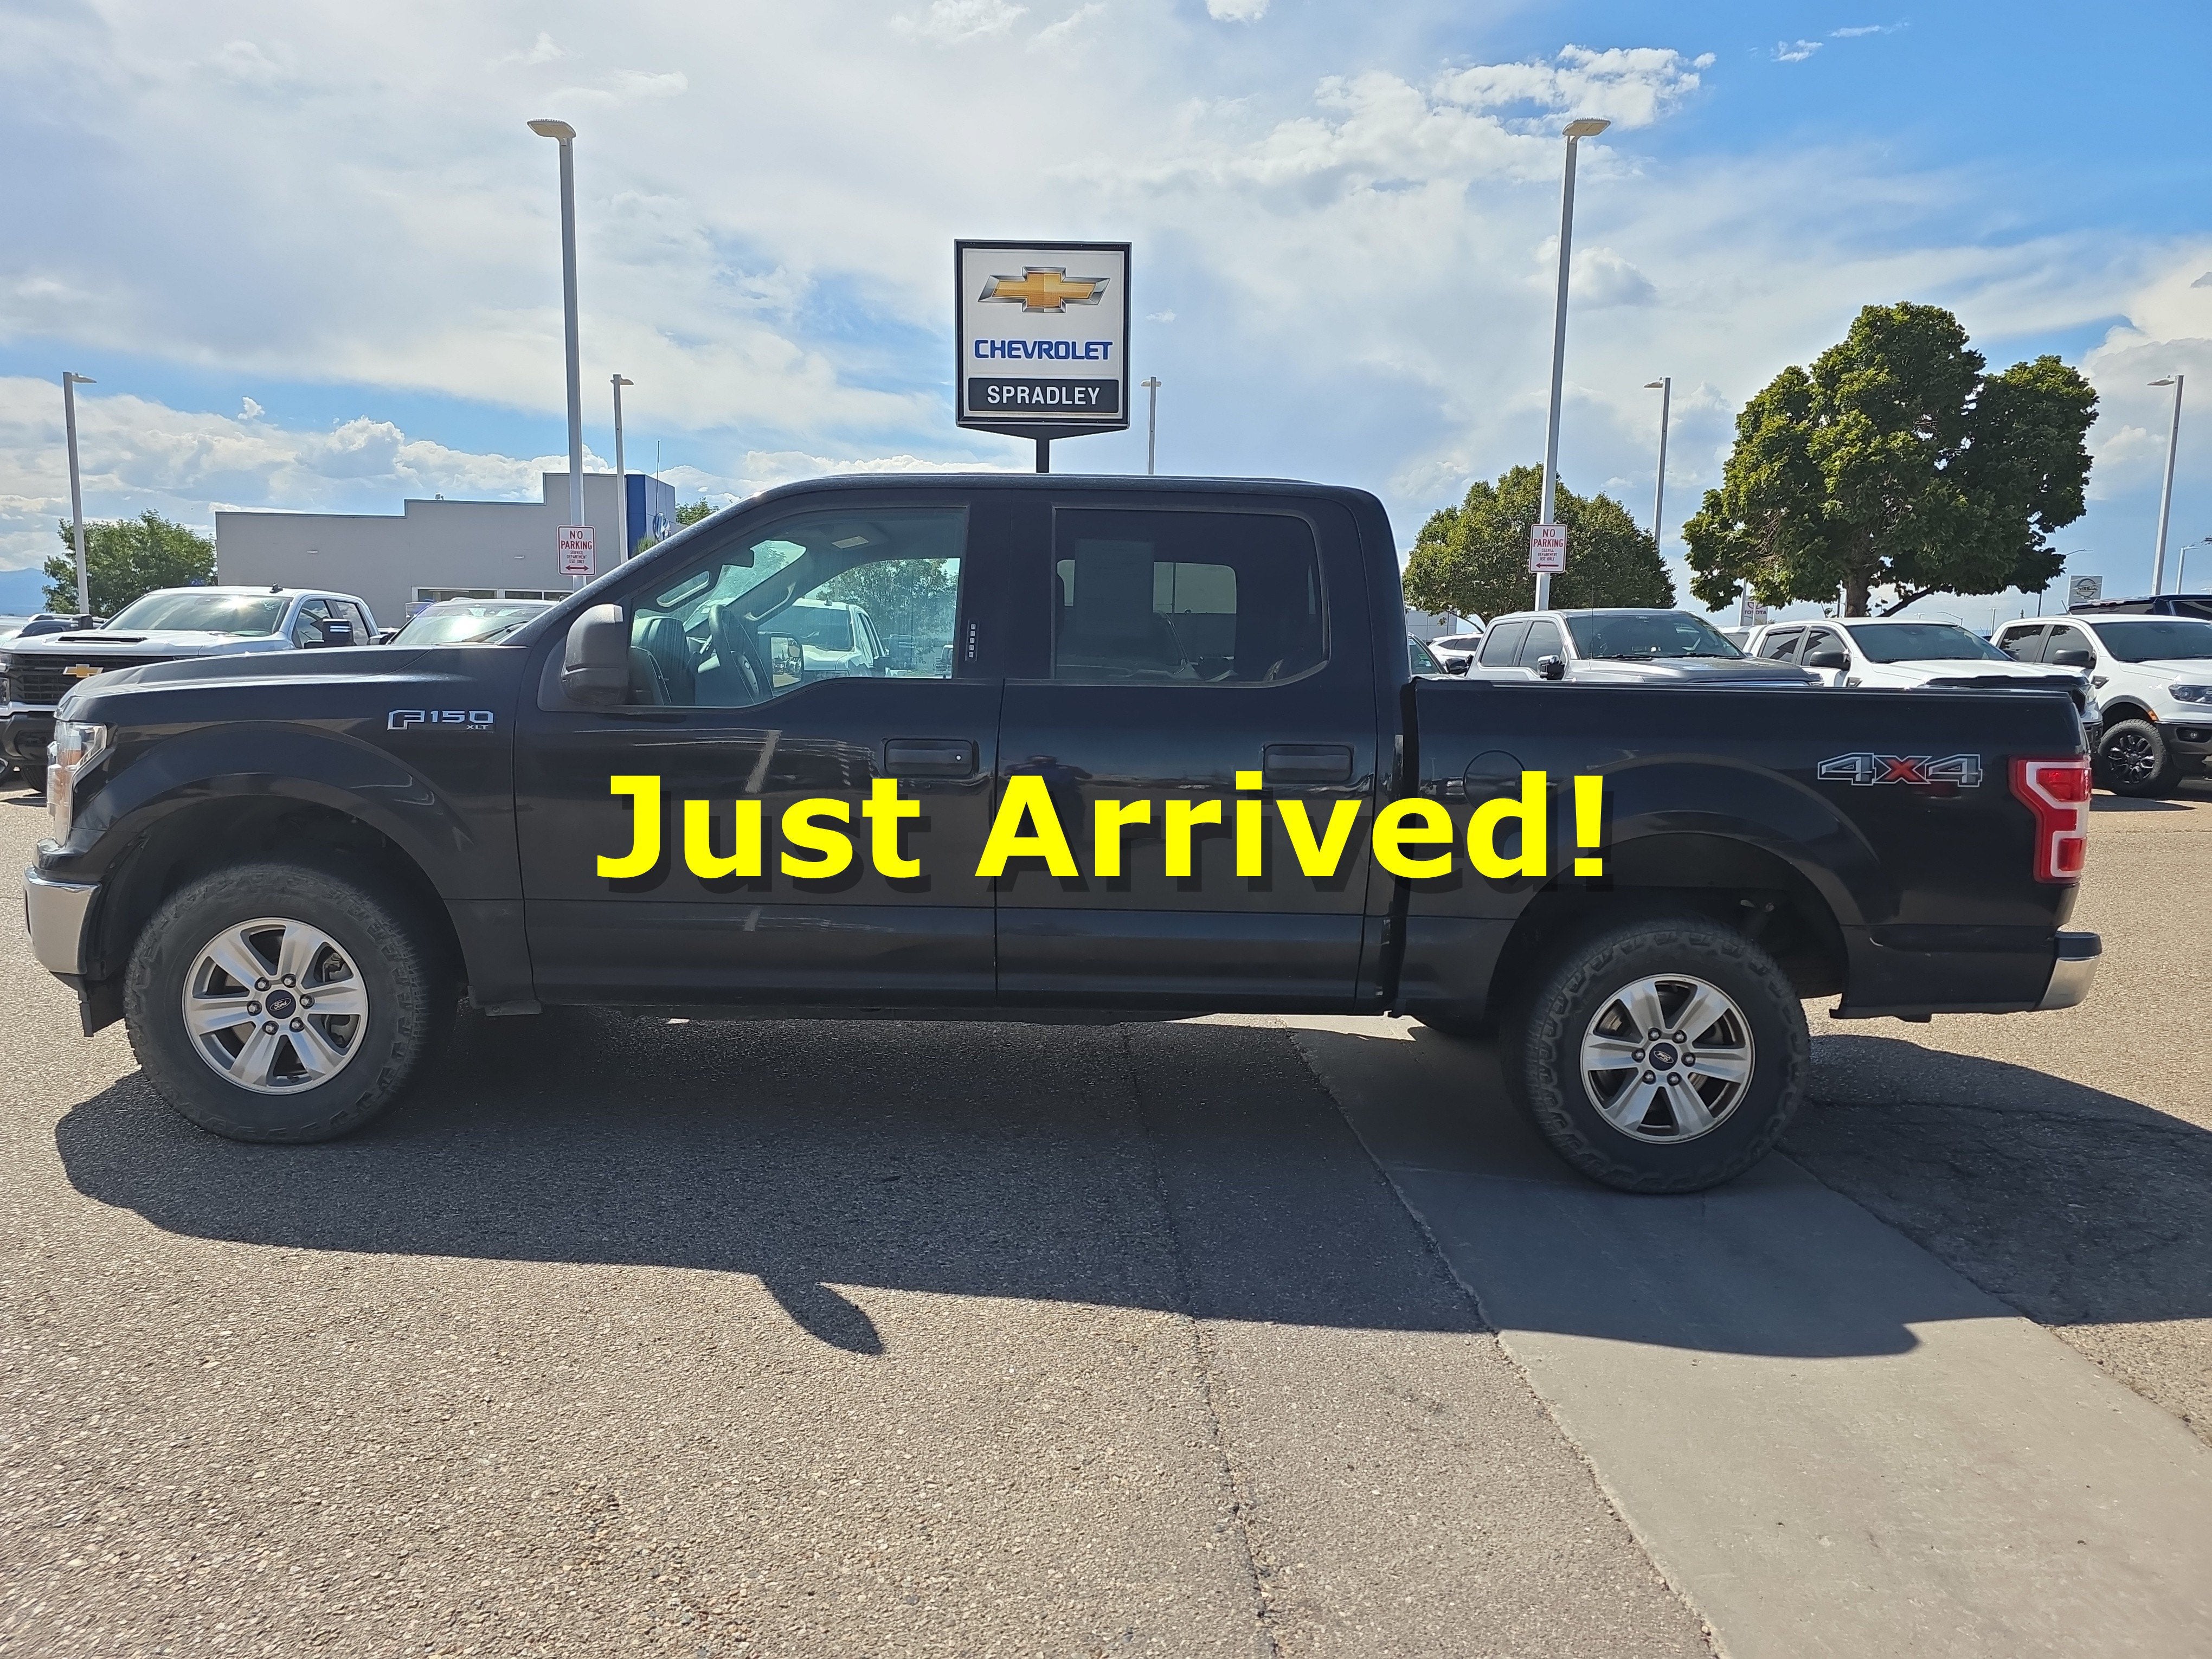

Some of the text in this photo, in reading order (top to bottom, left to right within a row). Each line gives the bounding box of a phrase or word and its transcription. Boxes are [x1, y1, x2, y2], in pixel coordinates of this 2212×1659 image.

[975, 339, 1113, 360] CHEVROLET
[987, 385, 1101, 406] SPRADLEY
[569, 530, 583, 539] NO
[1542, 529, 1555, 537] NO
[561, 540, 592, 550] PARKING
[1533, 538, 1564, 548] PARKING
